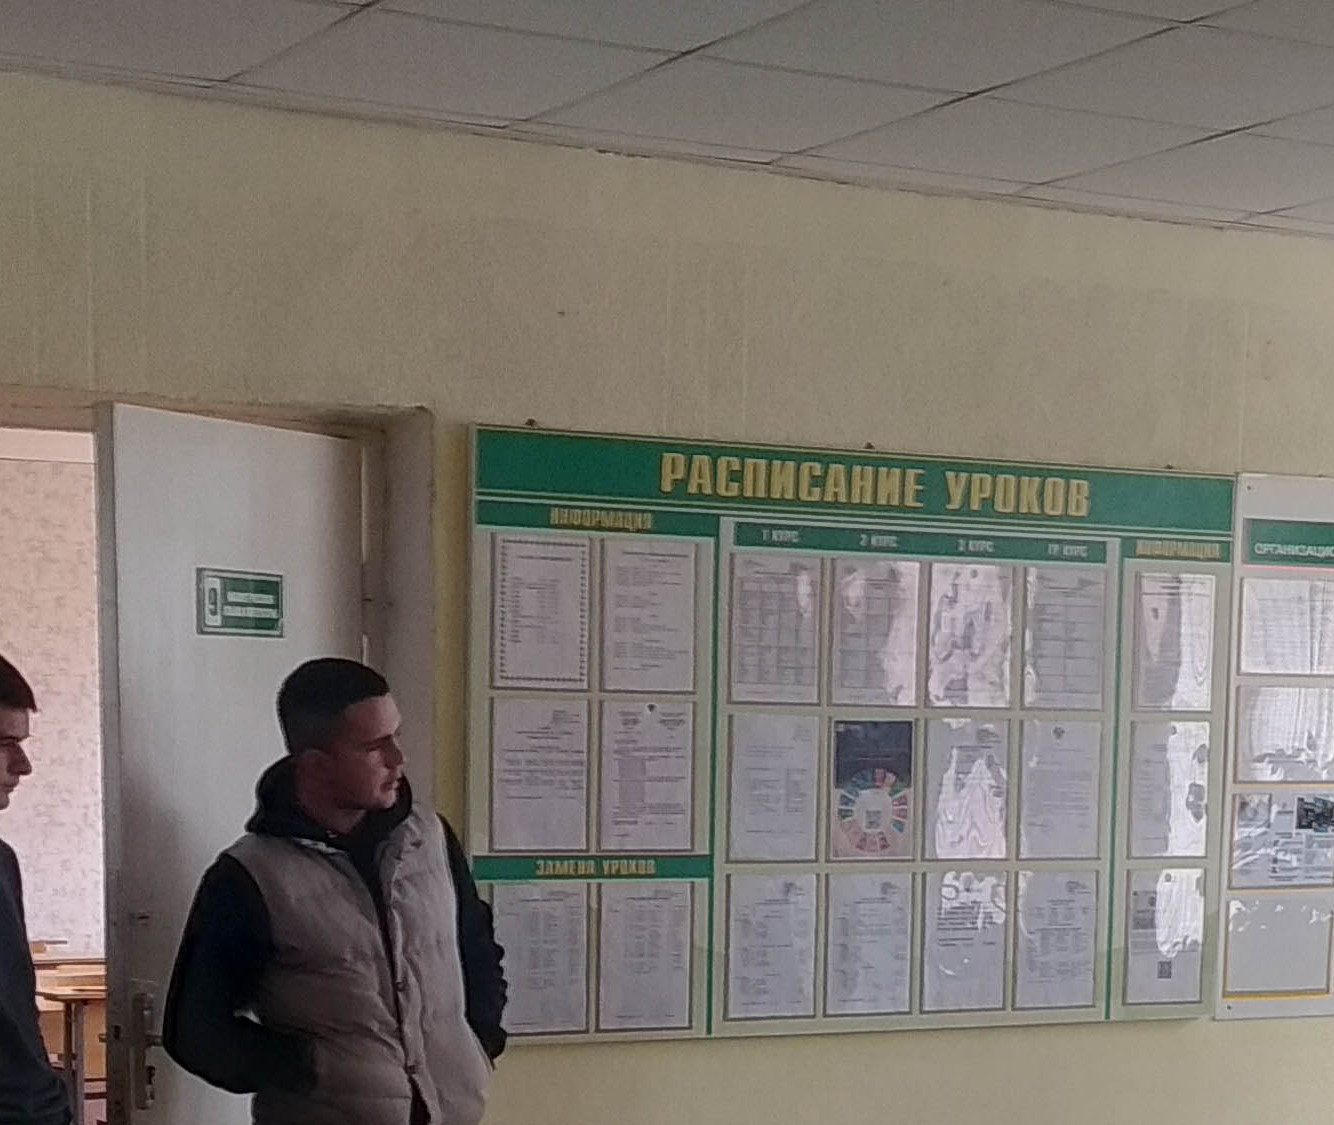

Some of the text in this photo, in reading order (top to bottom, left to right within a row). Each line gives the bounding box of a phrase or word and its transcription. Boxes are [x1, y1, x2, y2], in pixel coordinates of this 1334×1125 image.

[659, 452, 1090, 517] РАСПИСАНИЕ УРОКОВ
[535, 859, 656, 876] ЗАМЕНА УРОКОВ
